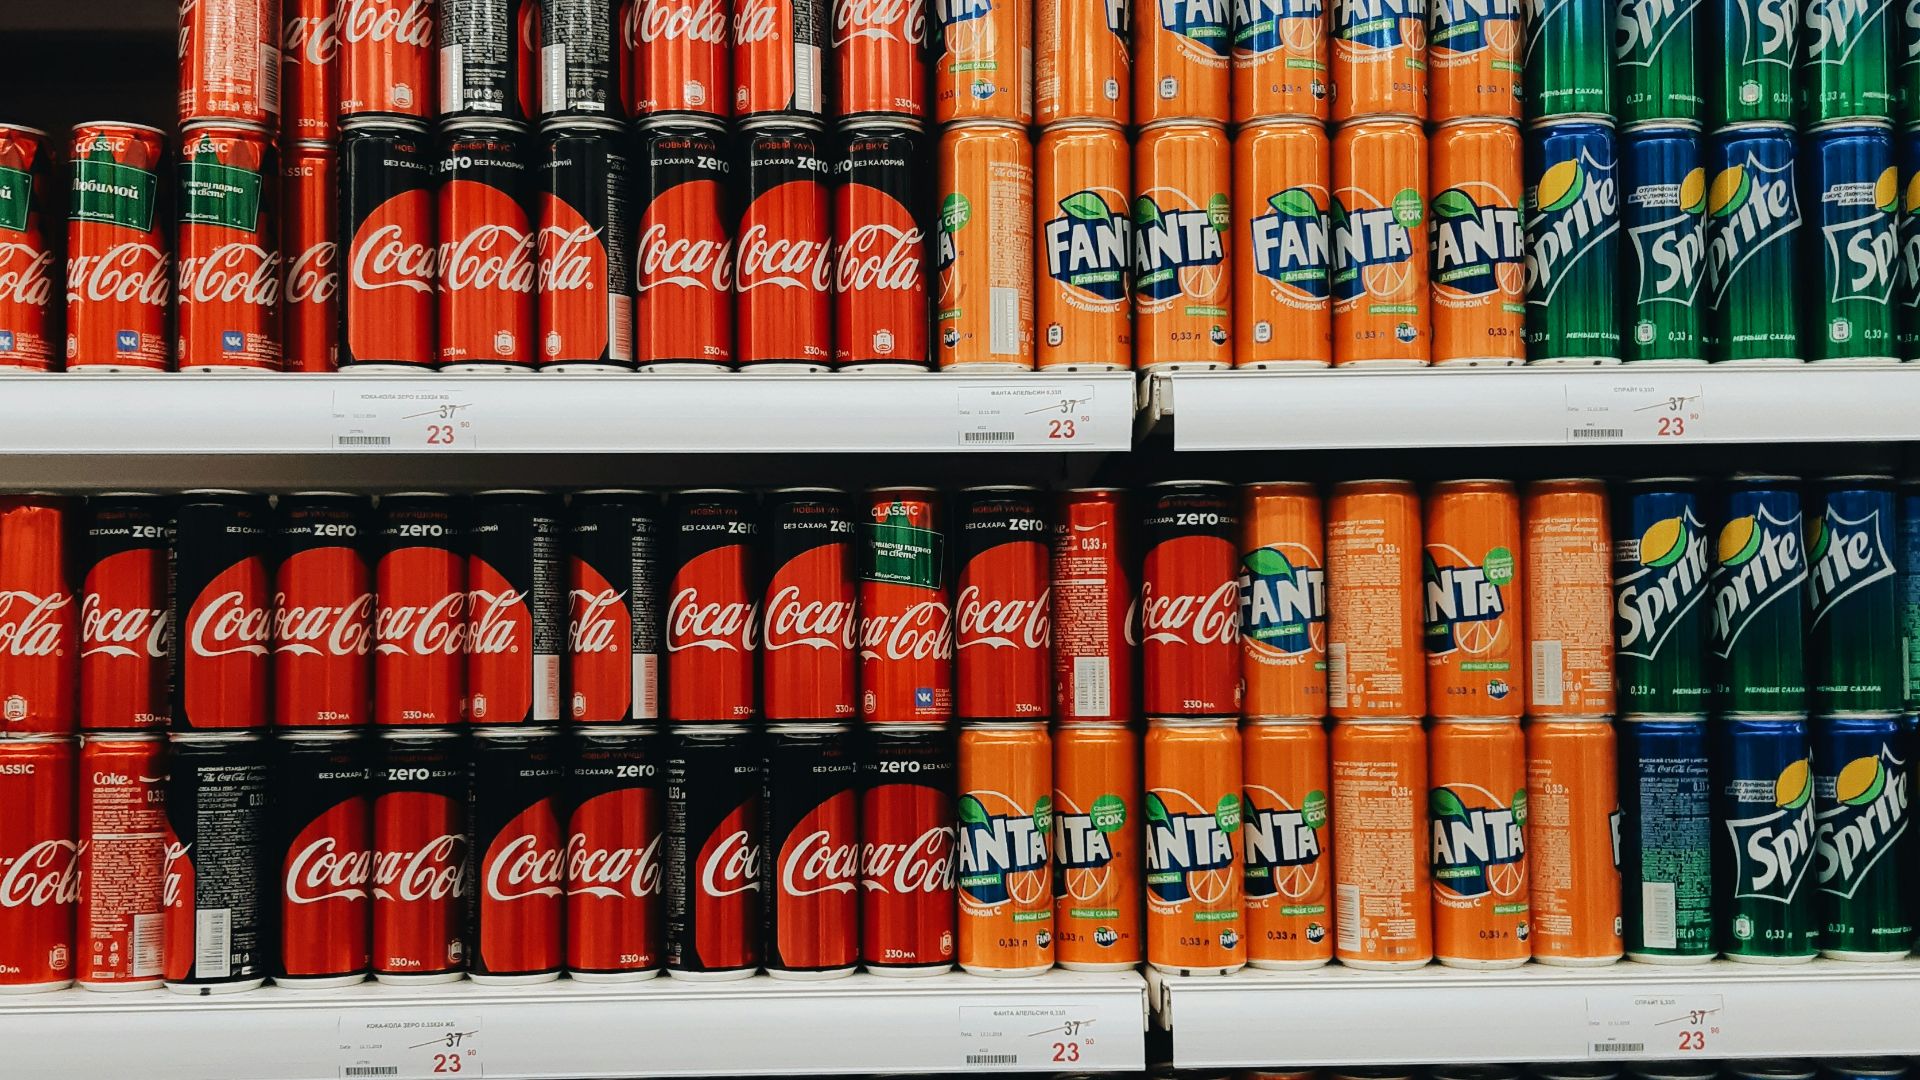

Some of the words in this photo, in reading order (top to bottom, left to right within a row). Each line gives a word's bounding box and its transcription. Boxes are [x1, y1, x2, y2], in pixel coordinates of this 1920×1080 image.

[895, 97, 912, 108] 330
[75, 140, 125, 153] CLASSIC
[183, 141, 228, 155] CLASSIC
[440, 156, 472, 172] zero
[474, 159, 488, 168] БЕЗ
[664, 158, 695, 166] САХАРА
[697, 156, 730, 173] zero
[763, 158, 795, 166] САХАРА
[797, 155, 829, 173] zero
[854, 160, 867, 168] БЕЗ
[868, 158, 905, 168] КАЛОРИЙ
[944, 213, 969, 228] СОК
[1441, 266, 1487, 282] Апельсин
[1171, 332, 1192, 342] 0,33
[1488, 327, 1507, 337] 0,33
[1668, 331, 1686, 341] 0,33
[1732, 334, 1768, 342] МЕНЬШЕ
[1769, 333, 1796, 341] САХАРА
[1864, 329, 1882, 339] 0,33
[703, 345, 720, 356] 330
[803, 345, 820, 356] 330
[1060, 399, 1077, 414] 37
[1668, 397, 1685, 411] 37
[439, 404, 457, 419] 37
[1048, 419, 1076, 439] 23
[1657, 417, 1685, 436] 23
[426, 424, 455, 445] 23
[460, 421, 471, 429] 90
[871, 505, 919, 517] CLASSIC
[1009, 518, 1043, 532] zero
[1176, 512, 1219, 526] zero
[314, 523, 357, 537] zero
[400, 523, 443, 537] zero
[682, 524, 695, 532] БЕЗ
[783, 523, 796, 531] БЕЗ
[797, 522, 828, 530] САХАРА
[1081, 537, 1100, 550] 0,33
[1377, 543, 1395, 554] 0,33
[1490, 567, 1512, 579] СОК
[1256, 626, 1303, 638] Апельсин
[1630, 685, 1648, 695] 0,33
[1744, 686, 1780, 694] МЕНЬШЕ
[733, 705, 750, 715] 330
[835, 704, 850, 713] 330
[1015, 704, 1033, 713] 330
[1183, 699, 1202, 709] 330
[134, 713, 154, 722] 330
[317, 711, 336, 720] 330
[402, 710, 421, 719] 330
[585, 768, 615, 776] САХАРА
[616, 764, 655, 778] zero
[734, 766, 747, 774] БЕЗ
[880, 760, 921, 773] zero
[922, 763, 935, 771] БЕЗ
[93, 772, 129, 785] Coke
[318, 772, 334, 780] БЕЗ
[388, 768, 430, 781] zero
[1391, 786, 1408, 798] 0,33
[1545, 784, 1563, 794] 0,33
[1096, 814, 1123, 826] СОК
[1095, 910, 1118, 918] САХАРА
[1094, 931, 1118, 943] FANTA
[1267, 931, 1288, 940] 0,33
[1479, 930, 1500, 940] 0,33
[1765, 928, 1785, 939] 0,33
[999, 938, 1019, 948] 0,33
[1180, 936, 1201, 947] 0,33
[620, 953, 638, 963] 330
[885, 949, 903, 959] 330
[390, 957, 407, 967] 330
[1690, 1010, 1706, 1025] 37
[1064, 1021, 1081, 1036] 37
[446, 1032, 463, 1048] 37
[1679, 1031, 1705, 1050] 23
[1052, 1042, 1080, 1062] 23
[433, 1053, 462, 1073] 23
